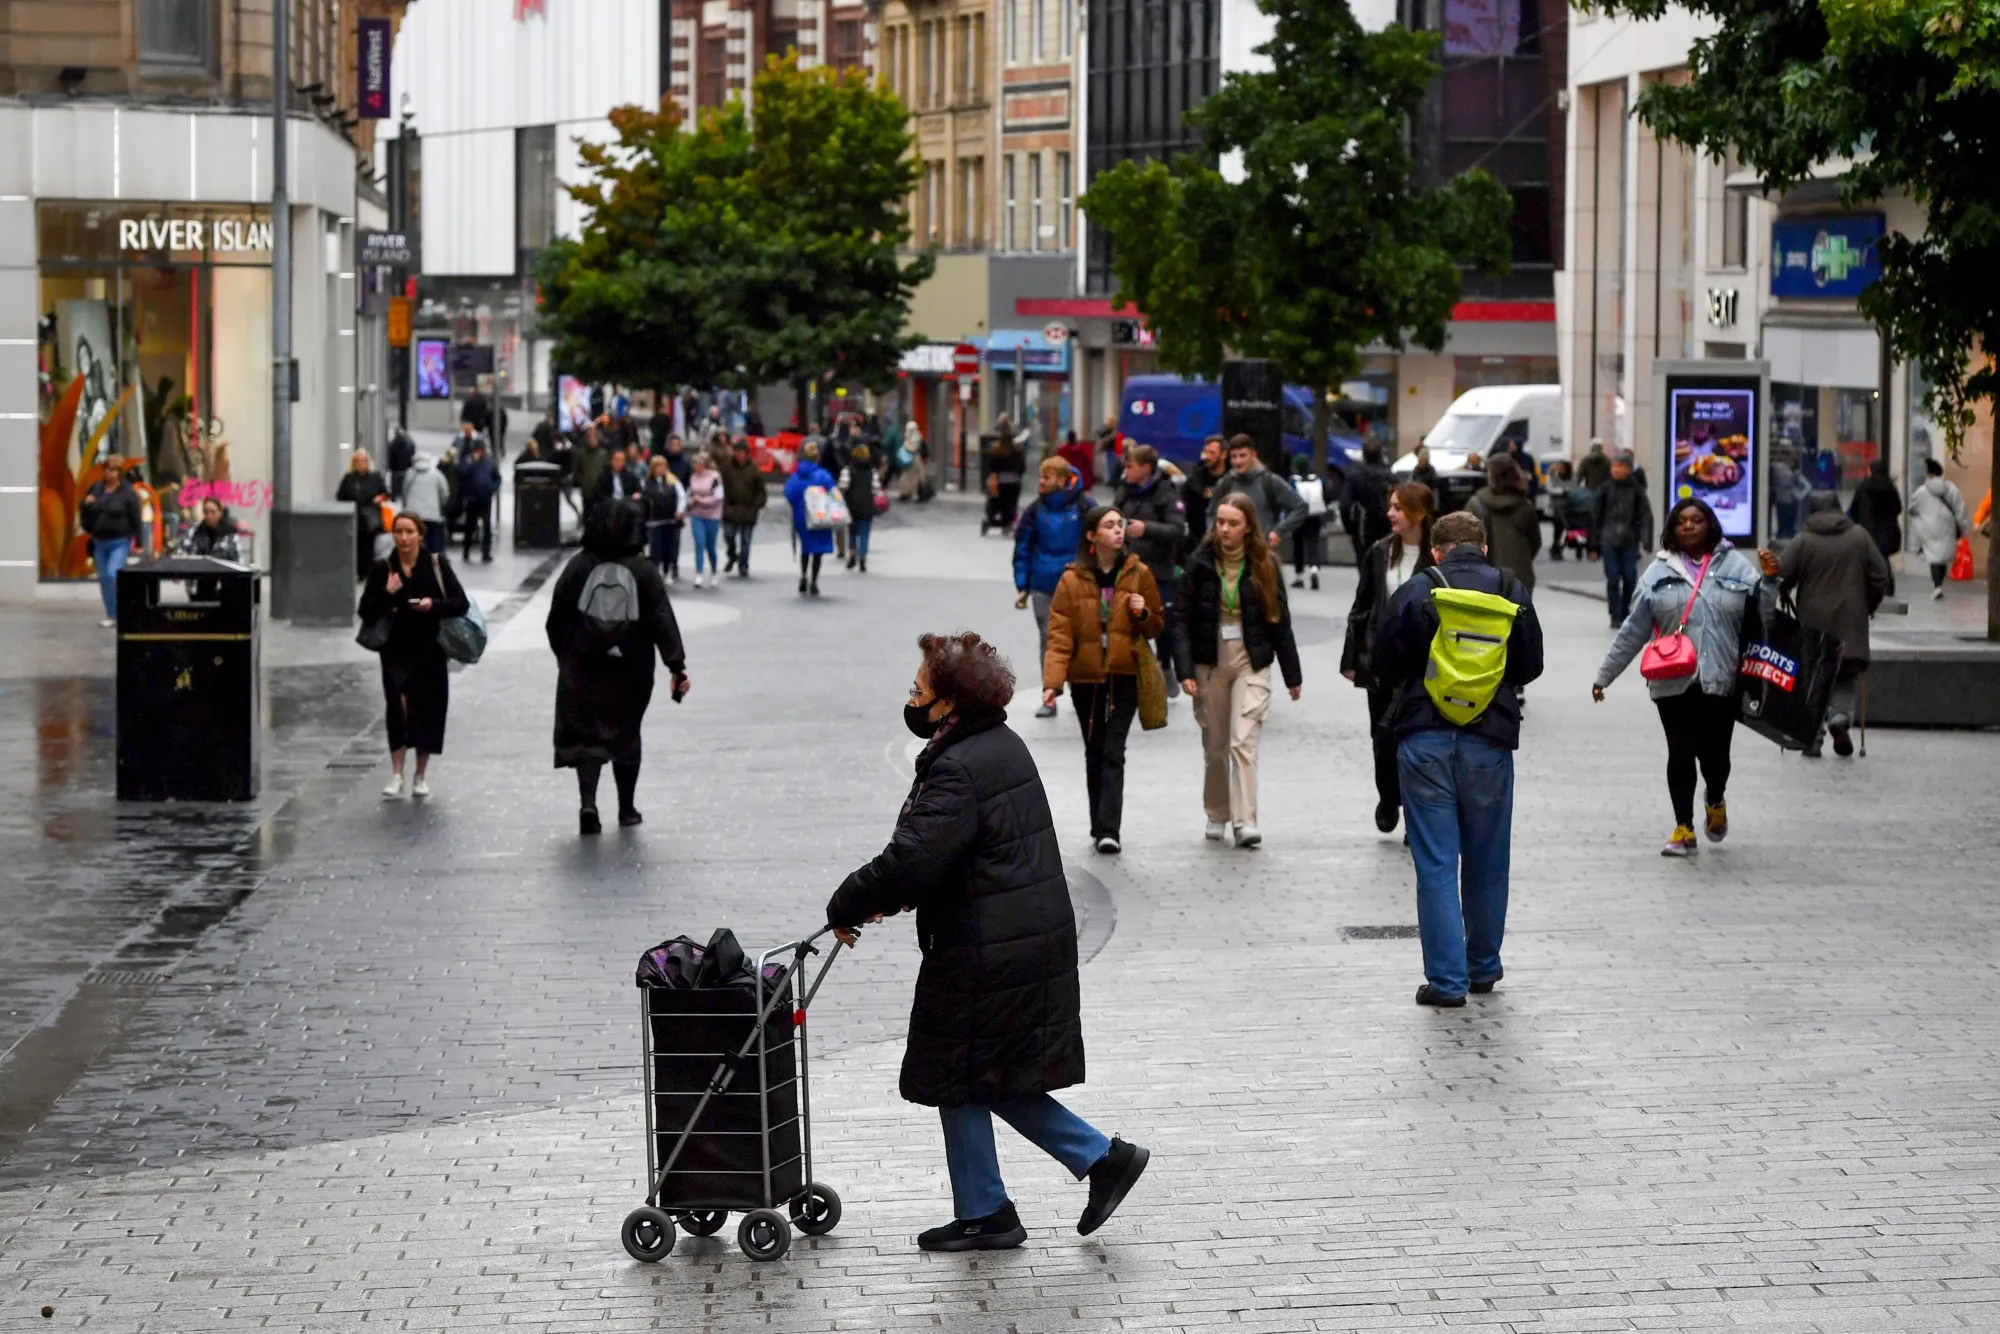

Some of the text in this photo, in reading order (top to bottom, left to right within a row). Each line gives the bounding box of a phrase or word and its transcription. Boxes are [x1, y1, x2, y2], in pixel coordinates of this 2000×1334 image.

[366, 30, 382, 91] NatWest
[118, 219, 204, 250] RIVER
[367, 234, 406, 249] RIVER
[362, 248, 412, 263] ISLAND
[1706, 287, 1740, 329] NEXT
